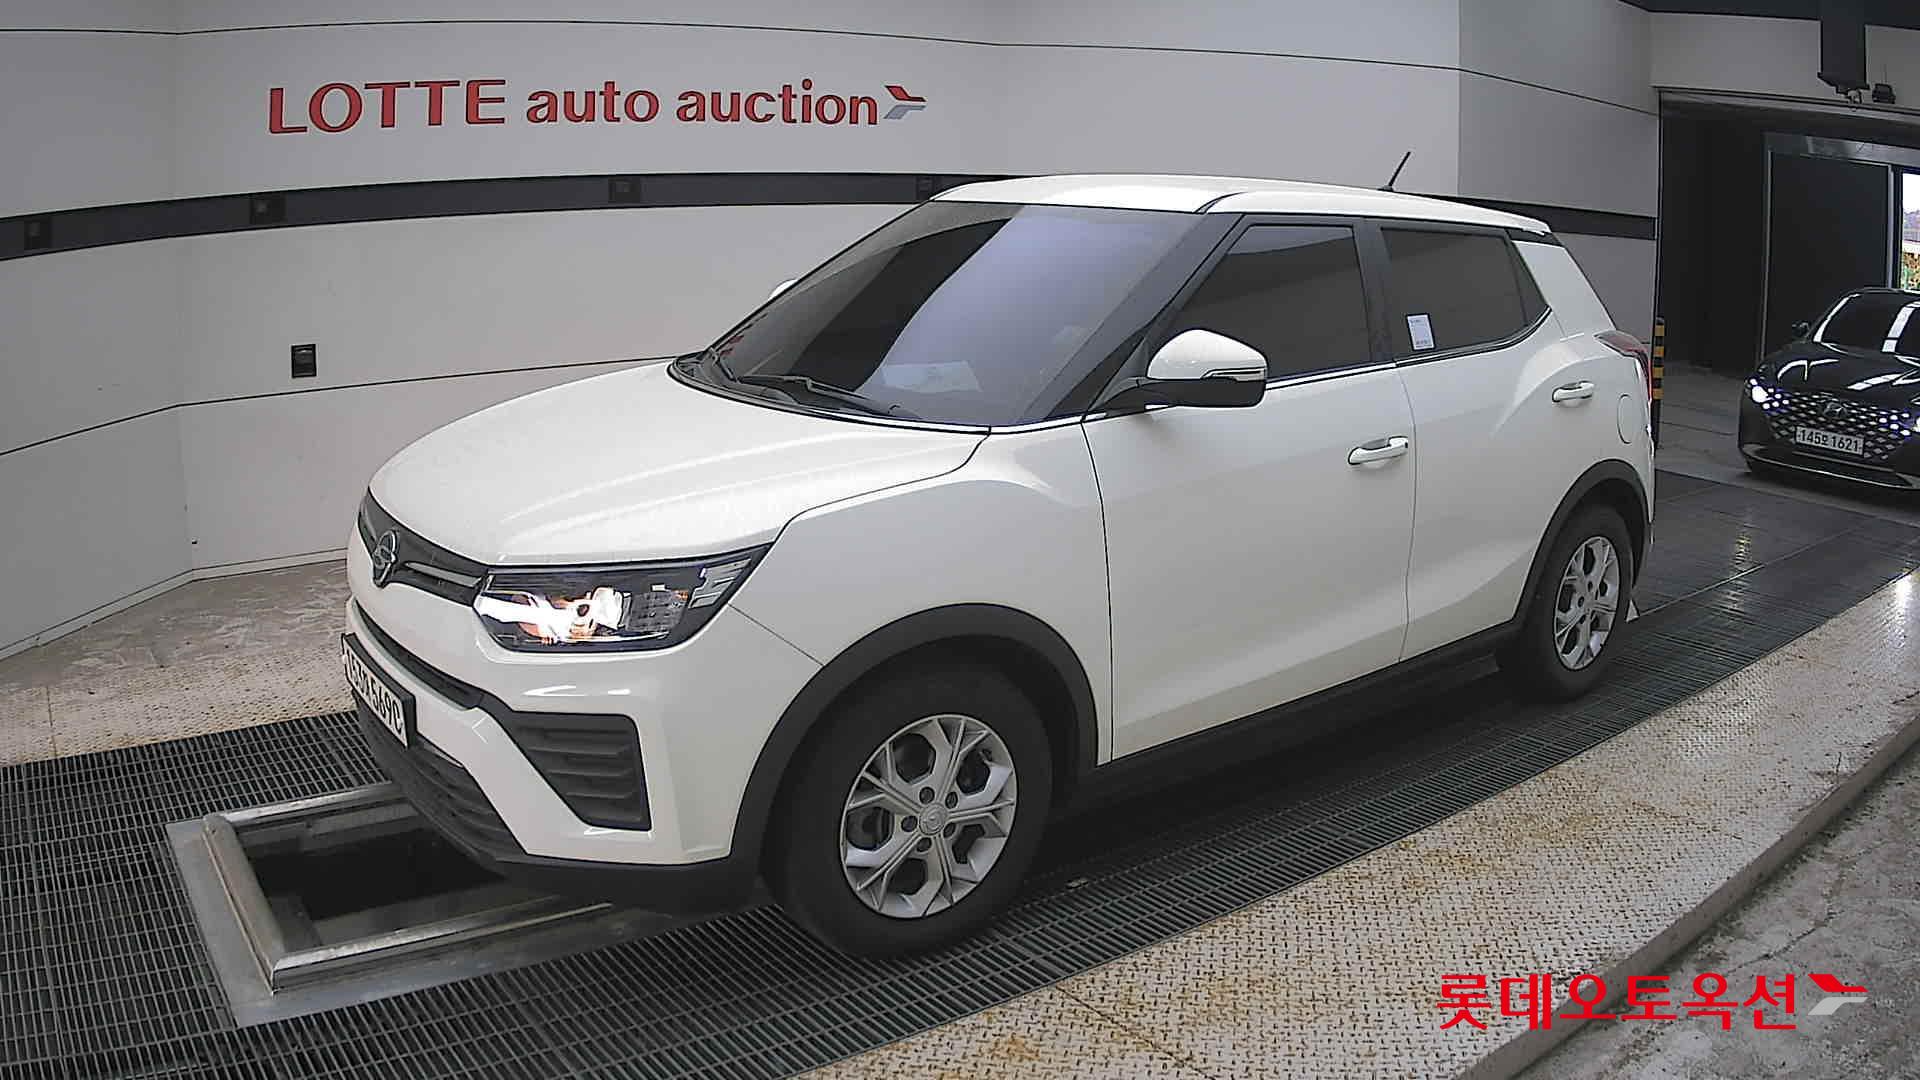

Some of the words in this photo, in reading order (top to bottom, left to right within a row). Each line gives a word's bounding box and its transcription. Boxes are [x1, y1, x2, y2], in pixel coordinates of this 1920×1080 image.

[268, 79, 507, 134] LOTTE
[525, 81, 660, 124] auto
[675, 79, 879, 125] auction
